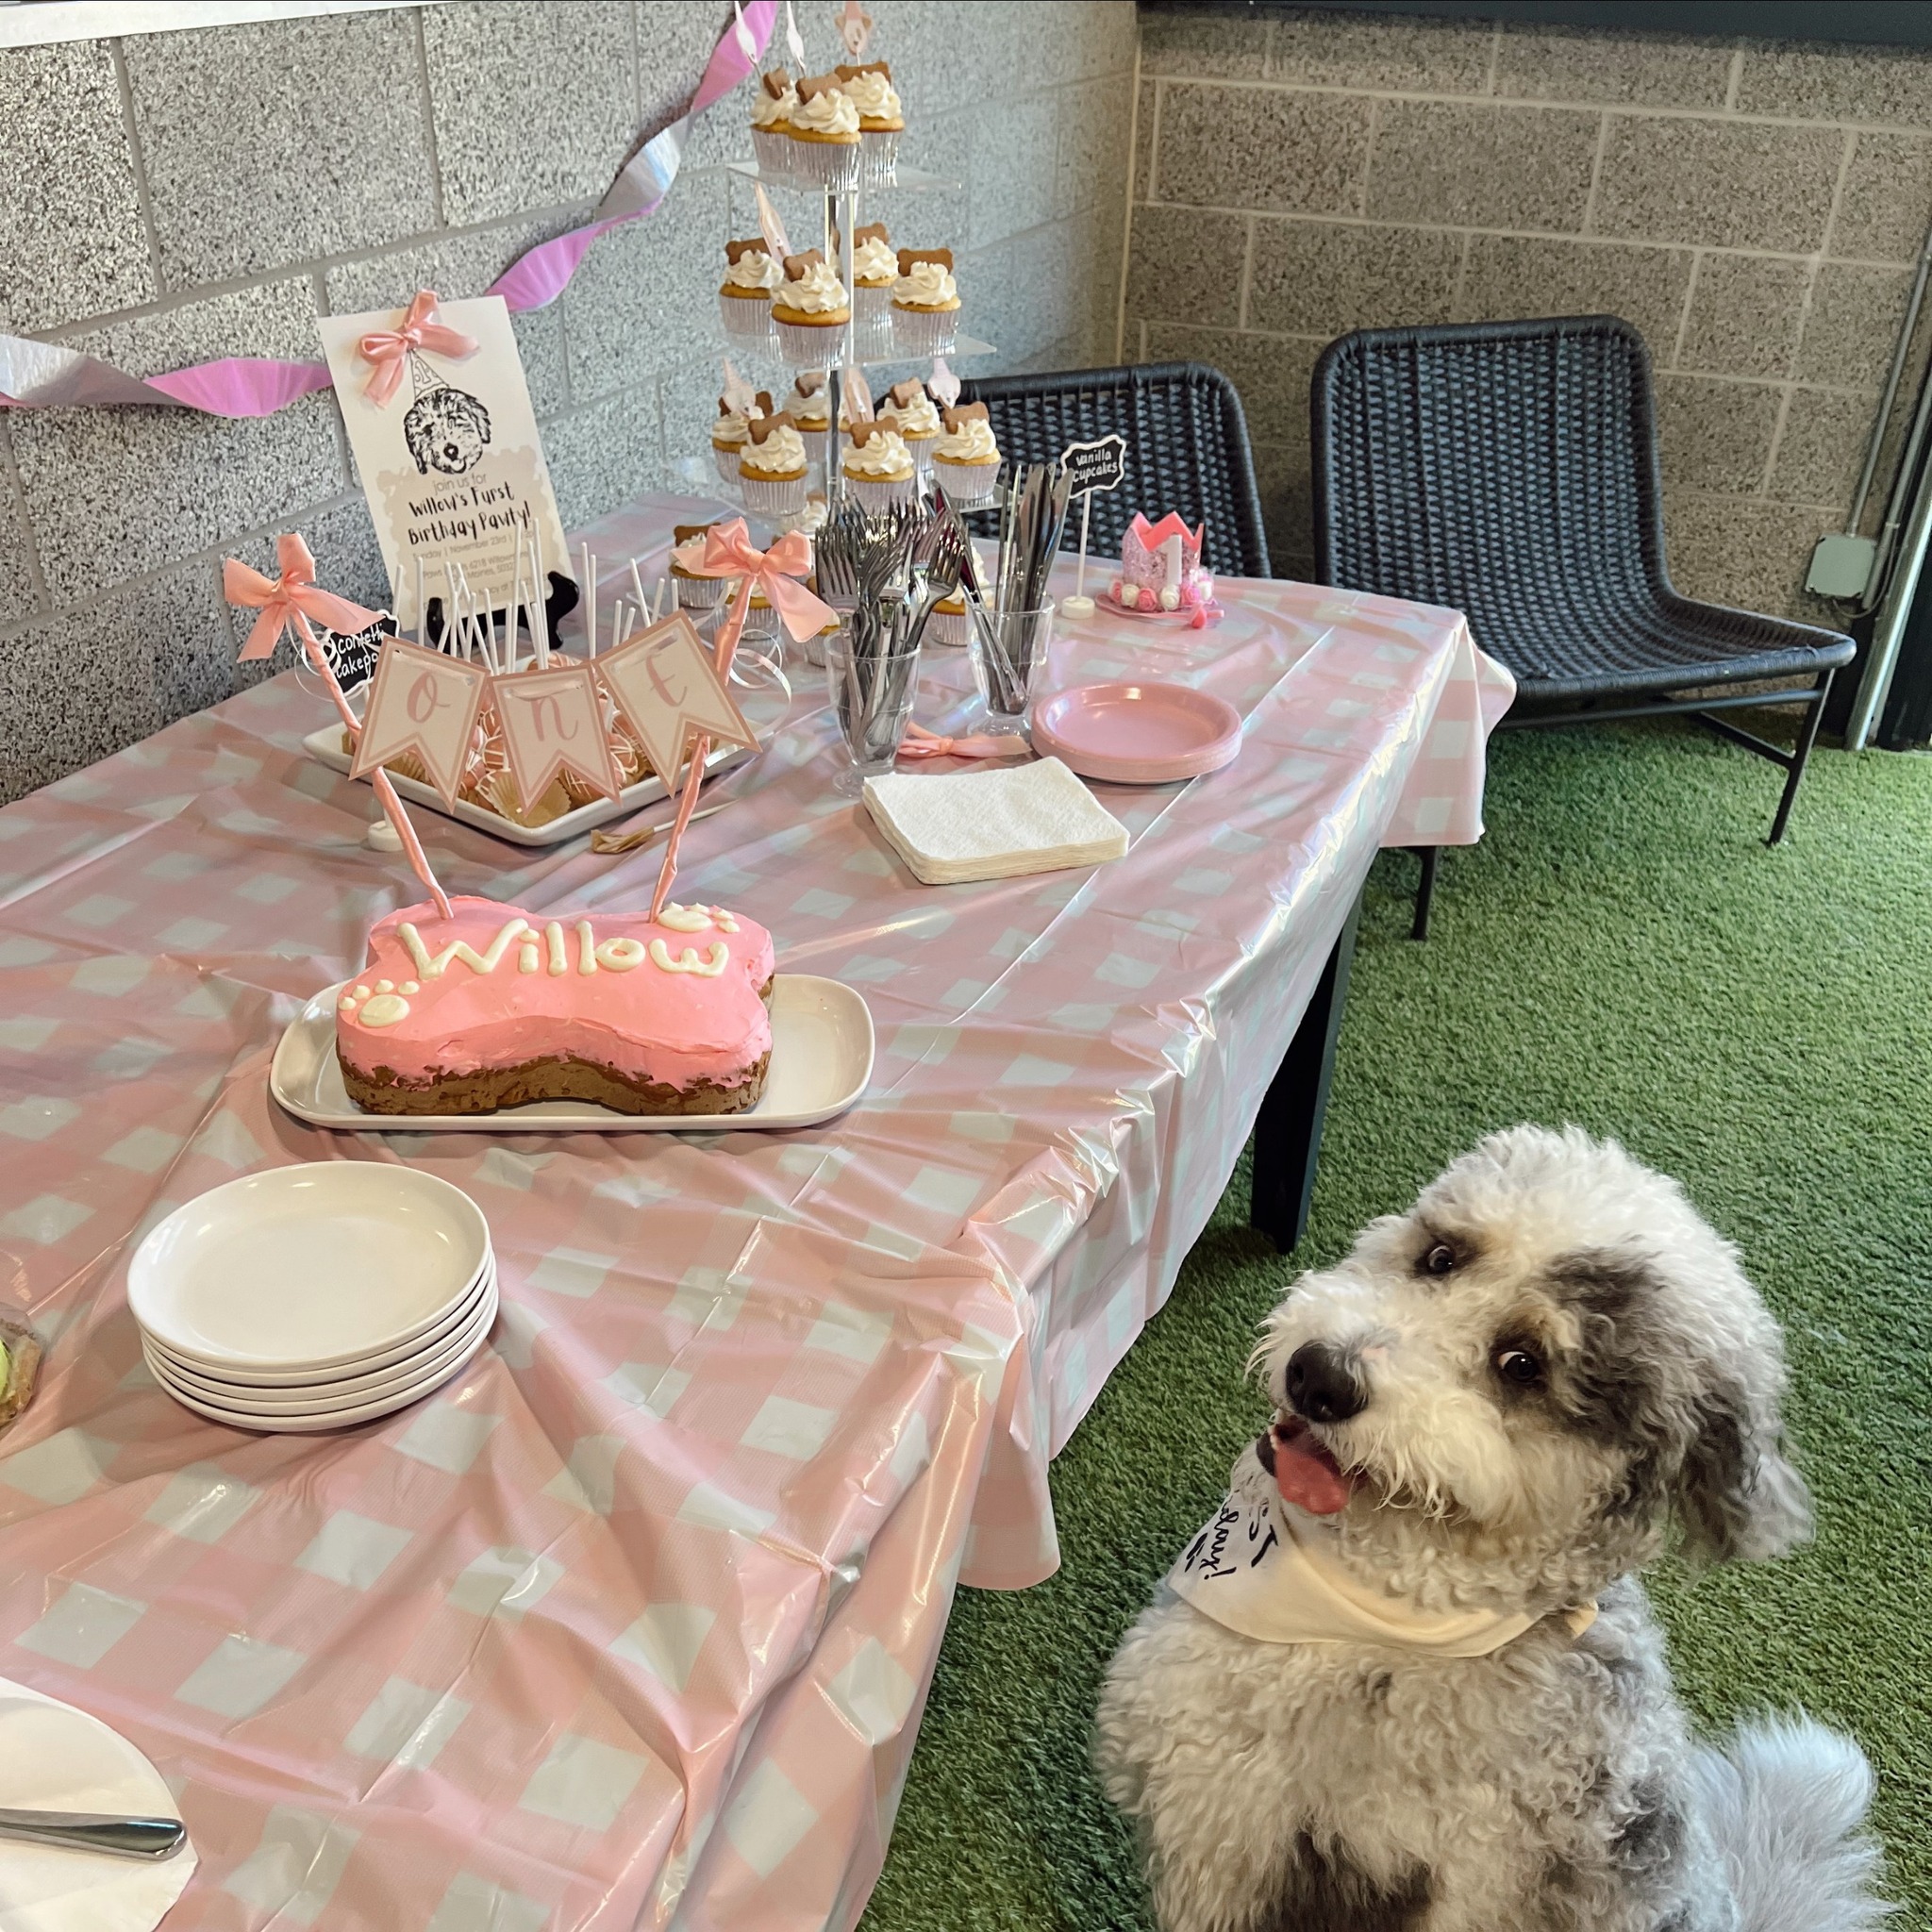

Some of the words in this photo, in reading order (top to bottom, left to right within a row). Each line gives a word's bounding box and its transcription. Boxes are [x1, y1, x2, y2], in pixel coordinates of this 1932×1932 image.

[1075, 449, 1111, 465] vanilla
[432, 478, 455, 495] join
[458, 477, 469, 491] us
[471, 472, 487, 486] for
[408, 493, 468, 517] Willow's
[408, 519, 477, 545] Birthday
[412, 548, 441, 562] Snday
[449, 540, 489, 553] November
[397, 919, 730, 982] Willow
